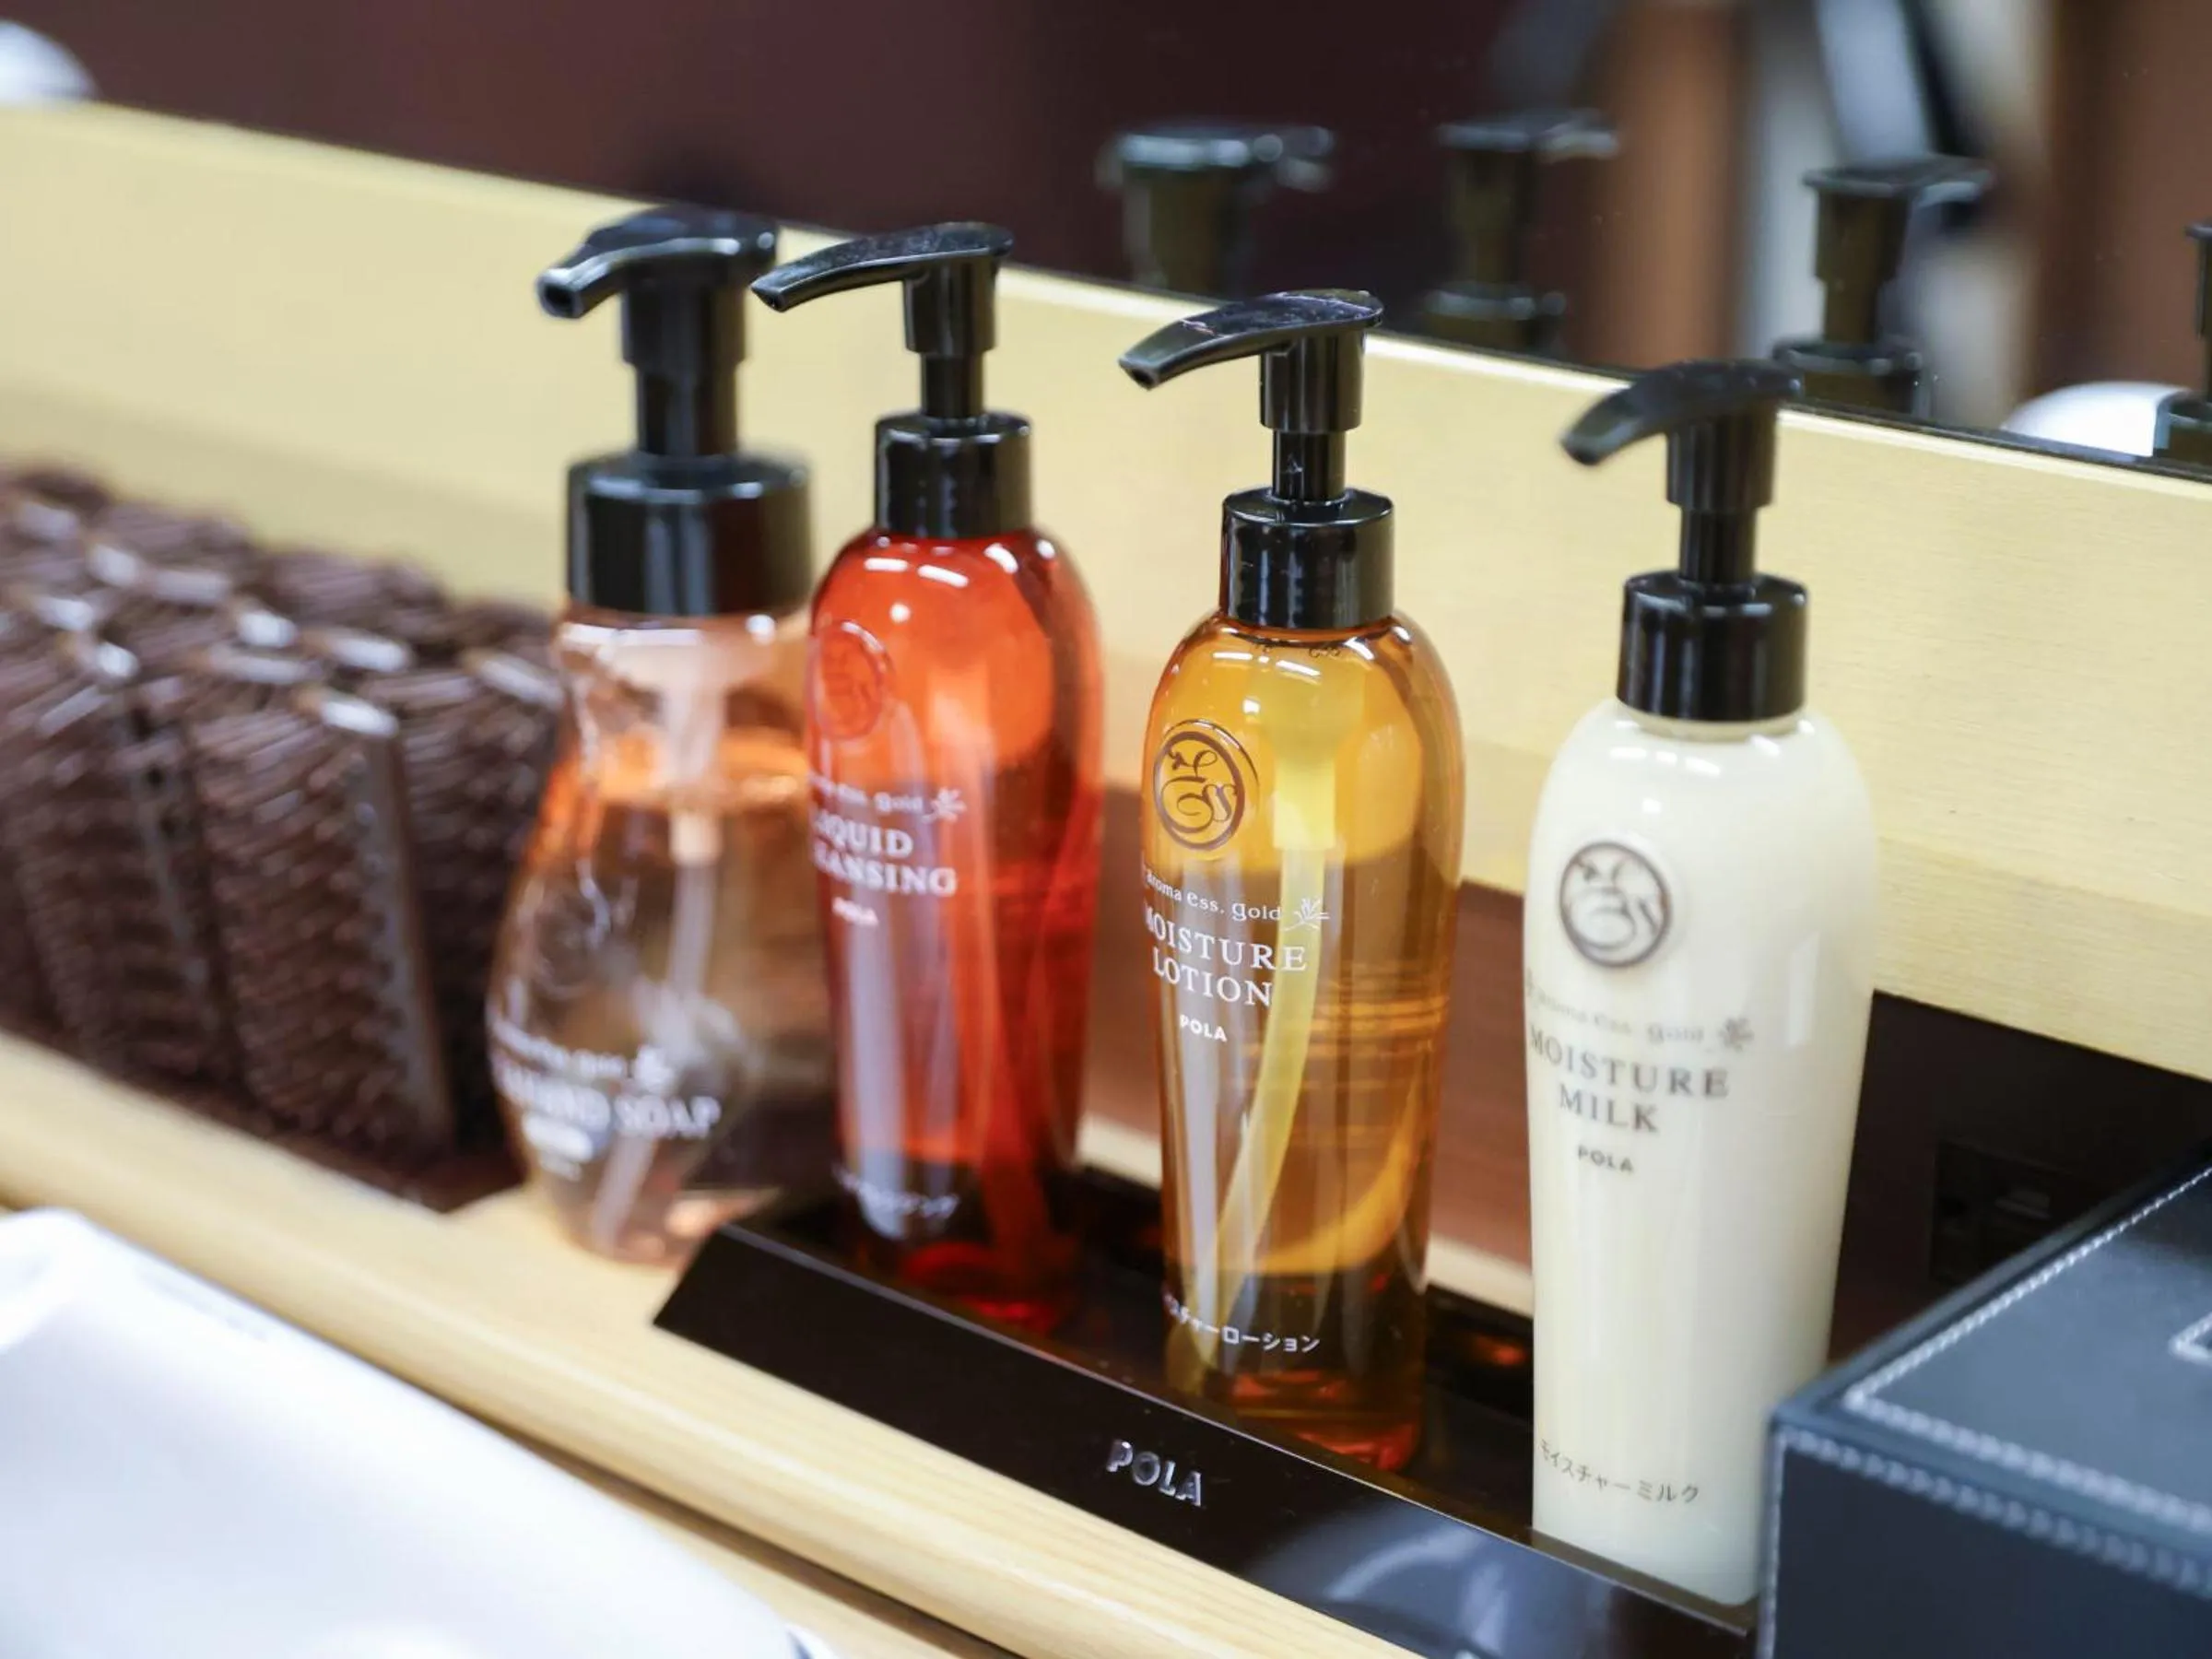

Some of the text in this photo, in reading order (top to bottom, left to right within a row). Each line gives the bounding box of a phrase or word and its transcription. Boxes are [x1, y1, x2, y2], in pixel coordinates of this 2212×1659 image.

[1231, 902, 1282, 922] gold
[1153, 947, 1273, 1009] LOTION
[1179, 1014, 1228, 1042] POLA
[1529, 1023, 1731, 1099] MOISTURE
[1559, 1081, 1659, 1134] MILK
[1577, 1144, 1635, 1173] POLA
[1107, 1440, 1202, 1508] POLA
[1540, 1439, 1700, 1503] モイスチャーミルク
